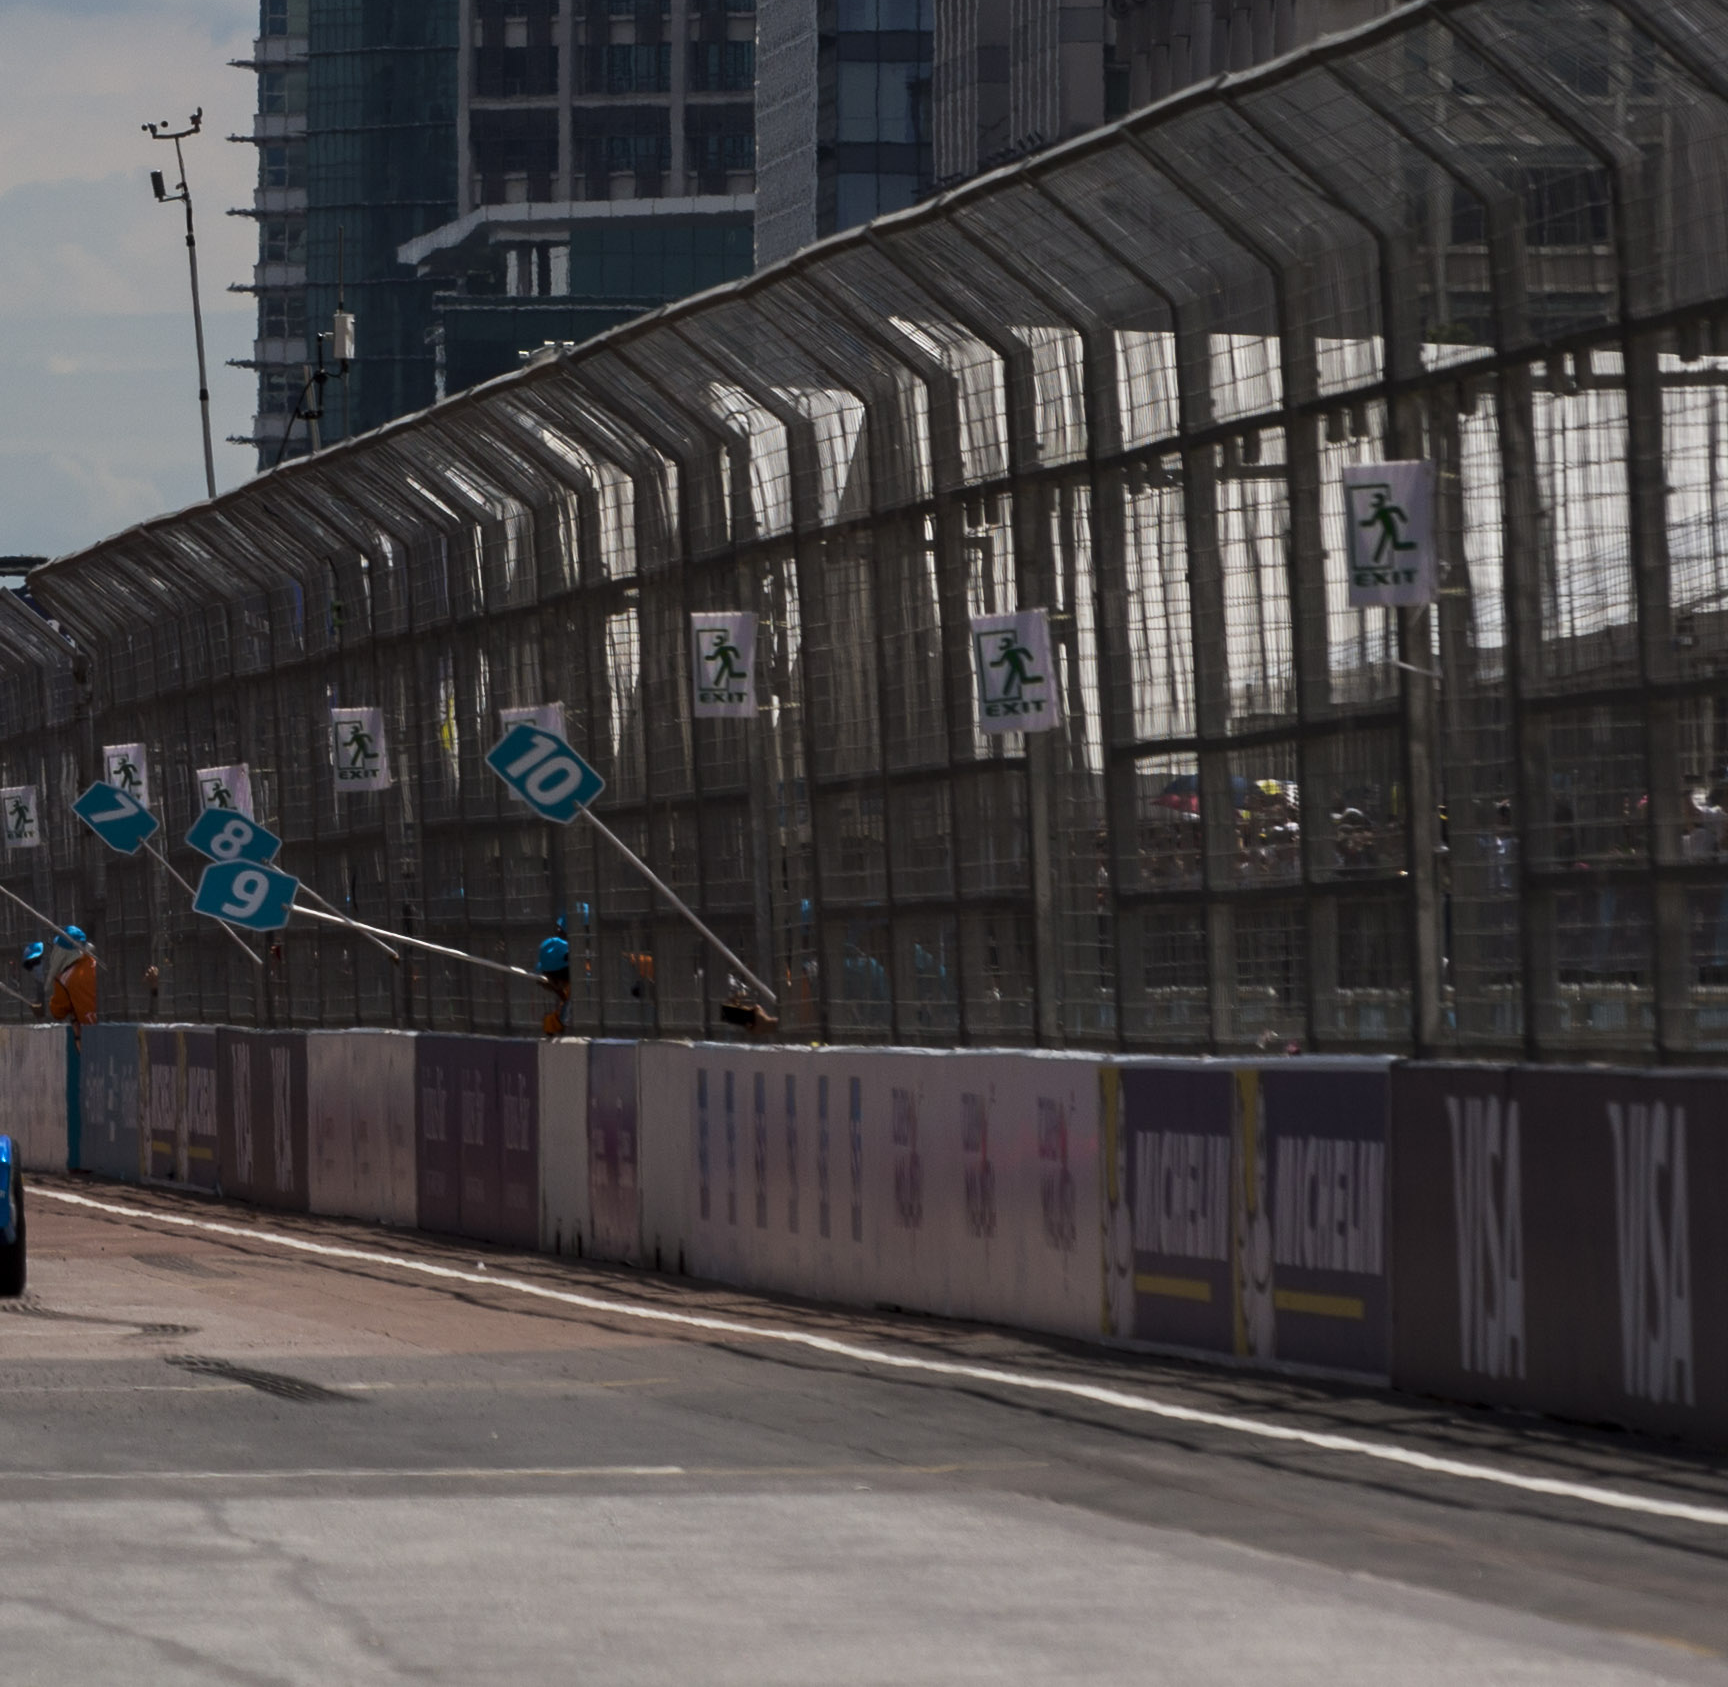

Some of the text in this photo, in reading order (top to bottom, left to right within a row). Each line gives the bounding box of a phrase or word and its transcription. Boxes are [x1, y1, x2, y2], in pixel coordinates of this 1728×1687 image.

[1354, 569, 1417, 587] EXIT
[699, 693, 748, 704] EXIT
[985, 700, 1047, 718] EXIT
[339, 769, 380, 781] EXIT
[505, 733, 582, 806] 10
[90, 792, 139, 825] 7
[209, 819, 254, 860] 8
[221, 869, 270, 918] 9
[1447, 1094, 1527, 1381] VISA
[1606, 1098, 1697, 1408] VISA
